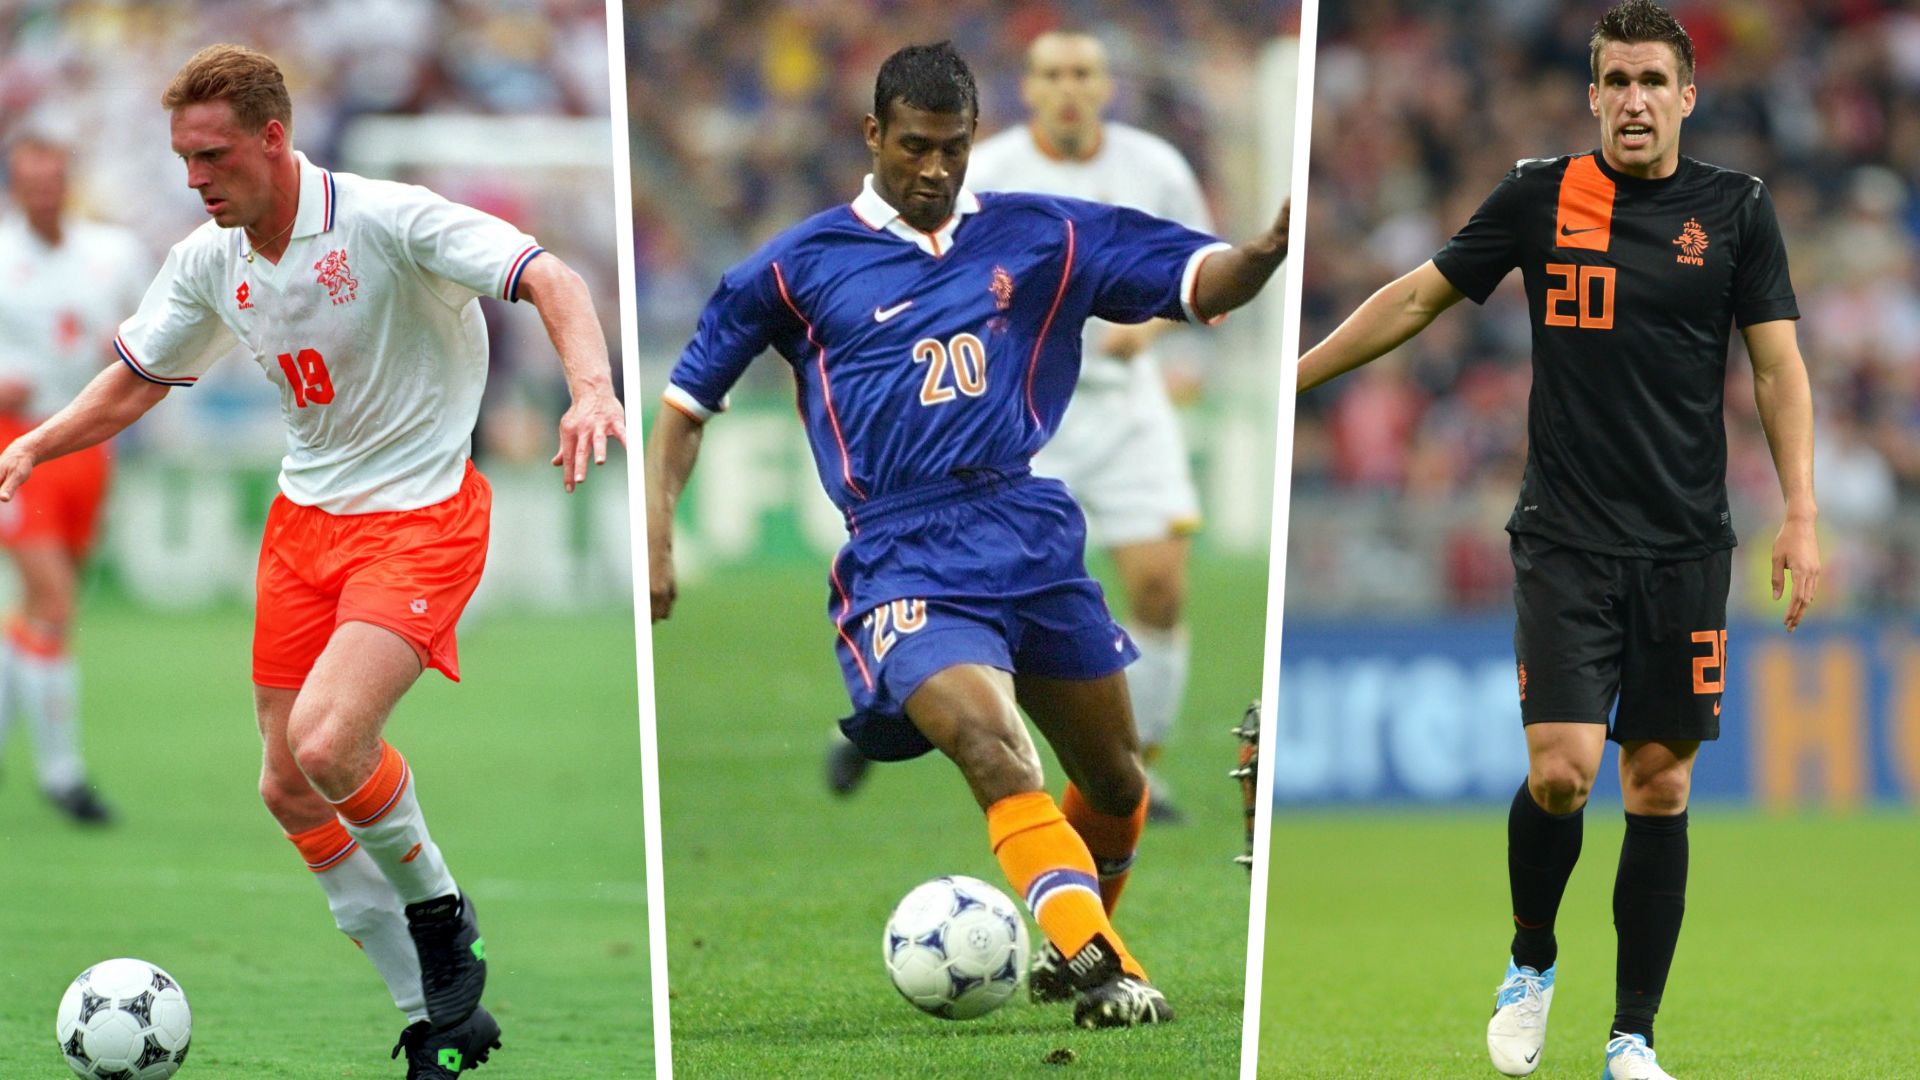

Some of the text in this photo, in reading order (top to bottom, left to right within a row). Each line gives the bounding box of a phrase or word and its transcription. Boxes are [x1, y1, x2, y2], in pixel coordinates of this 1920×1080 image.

[1676, 254, 1704, 267] KNVB
[1544, 263, 1617, 330] 20
[276, 347, 336, 409] 19
[912, 332, 987, 406] 20
[1691, 629, 1727, 694] 2
